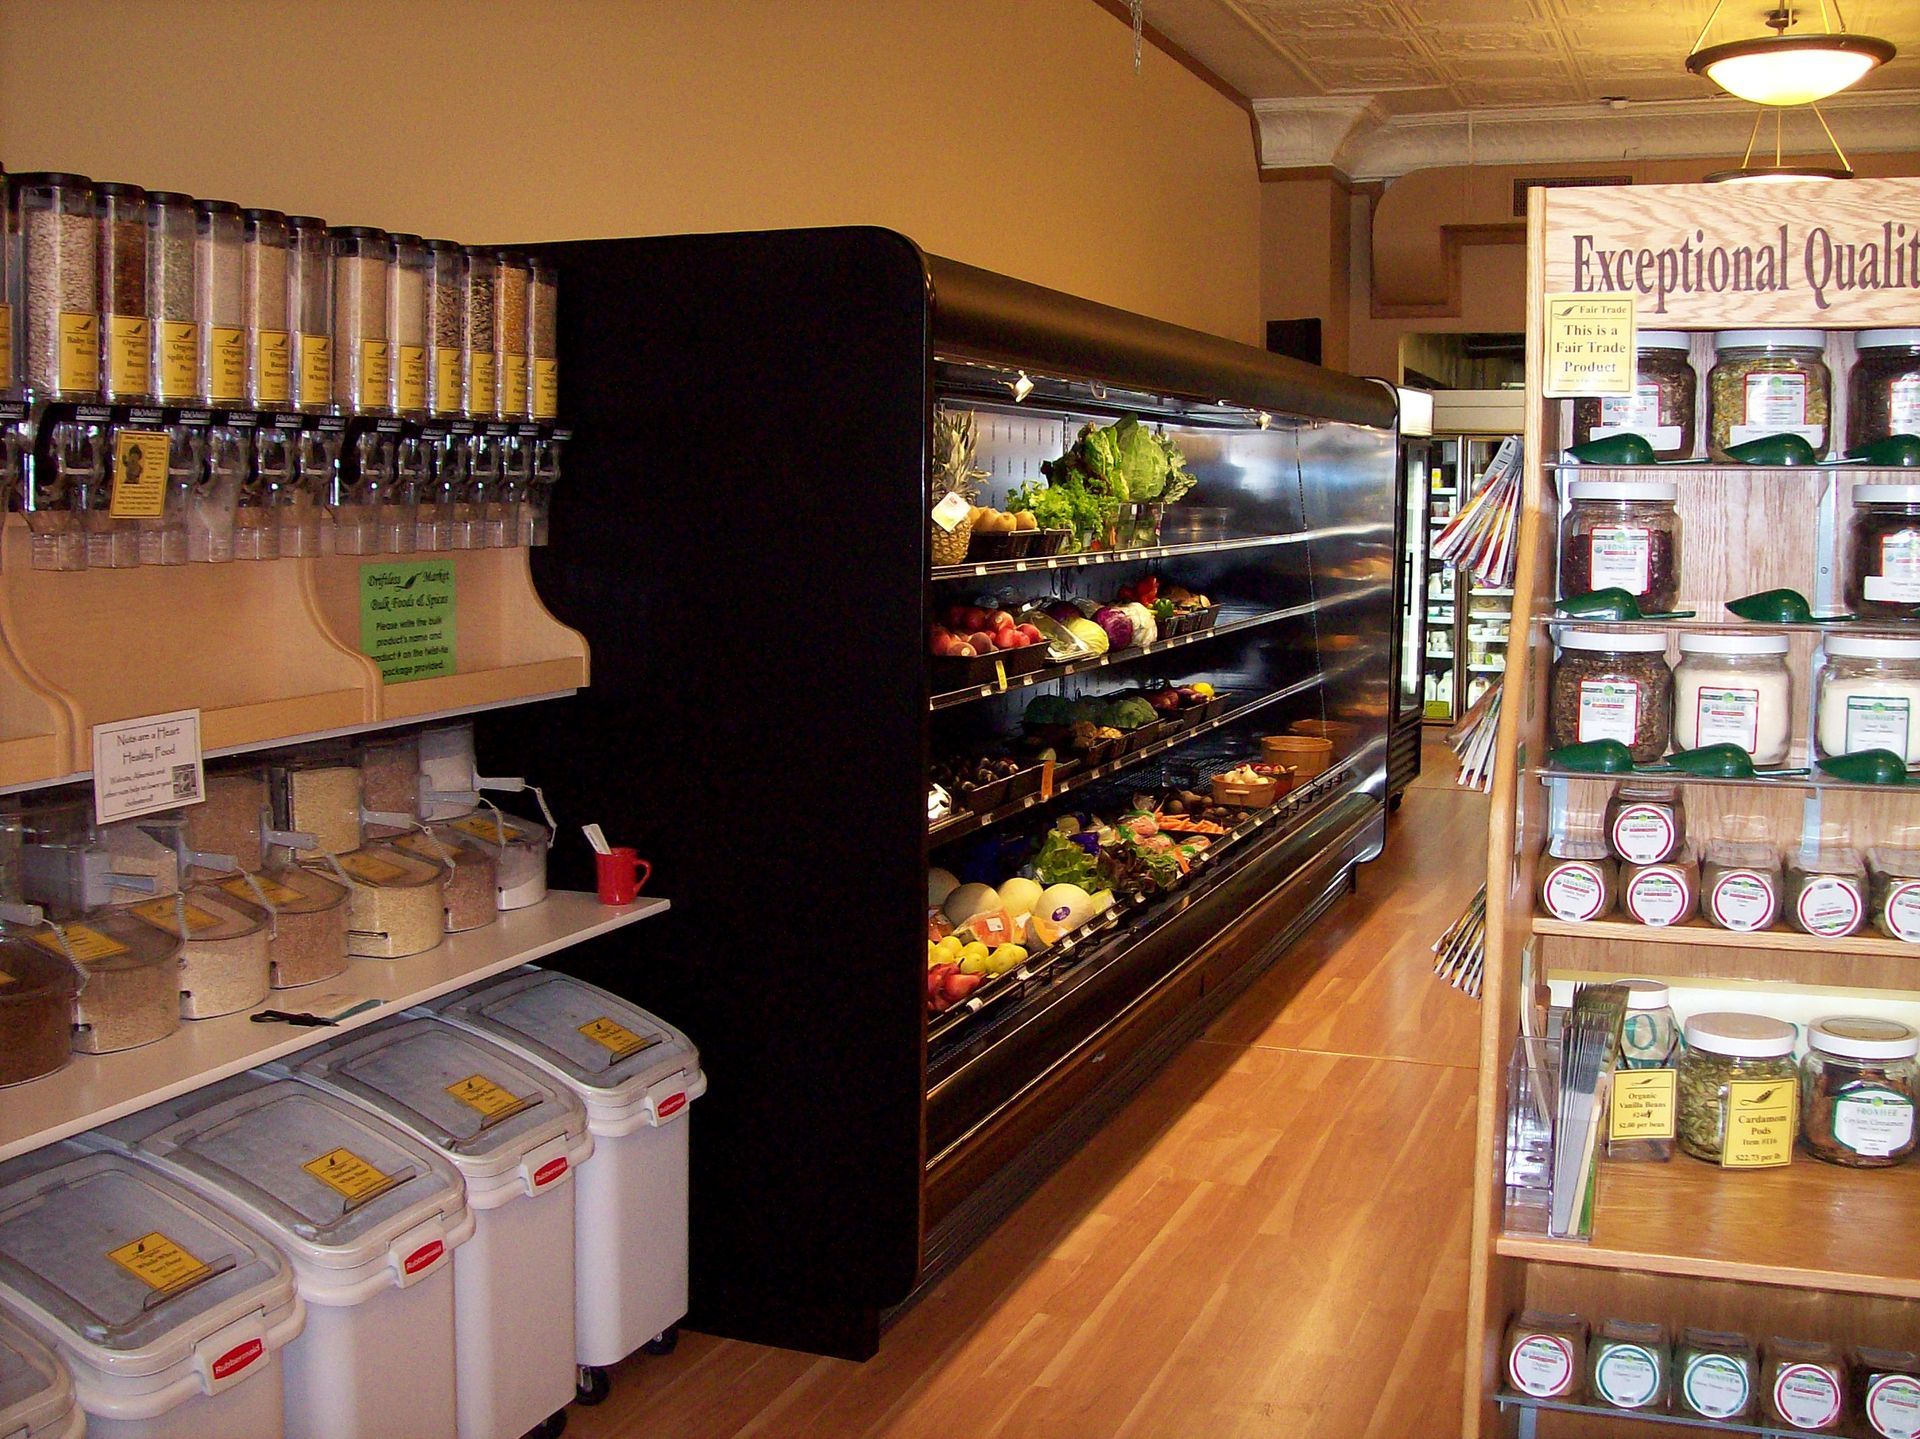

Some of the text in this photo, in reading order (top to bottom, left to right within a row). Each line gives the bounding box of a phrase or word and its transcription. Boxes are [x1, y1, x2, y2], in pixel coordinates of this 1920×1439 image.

[1572, 223, 1789, 314] Exceptional
[1579, 305, 1627, 314] Fair Trade
[1564, 324, 1592, 335] This
[1596, 324, 1607, 335] is
[1556, 341, 1626, 353] Fair Trade
[1564, 361, 1616, 373] Product
[392, 594, 415, 609] Foods
[426, 593, 449, 609] Spices
[376, 621, 398, 631] Please
[416, 617, 427, 626] the
[409, 634, 428, 642] name
[429, 631, 442, 639] and
[413, 648, 423, 657] the
[117, 734, 136, 746] Nuts
[137, 734, 150, 742] are
[157, 726, 181, 739] Heart
[122, 743, 176, 765] Healthy Food
[1628, 1092, 1657, 1100] Organic
[1738, 1115, 1787, 1124] Cardamom
[1751, 1127, 1772, 1135] Pods
[215, 1344, 262, 1375] Rubbermaid
